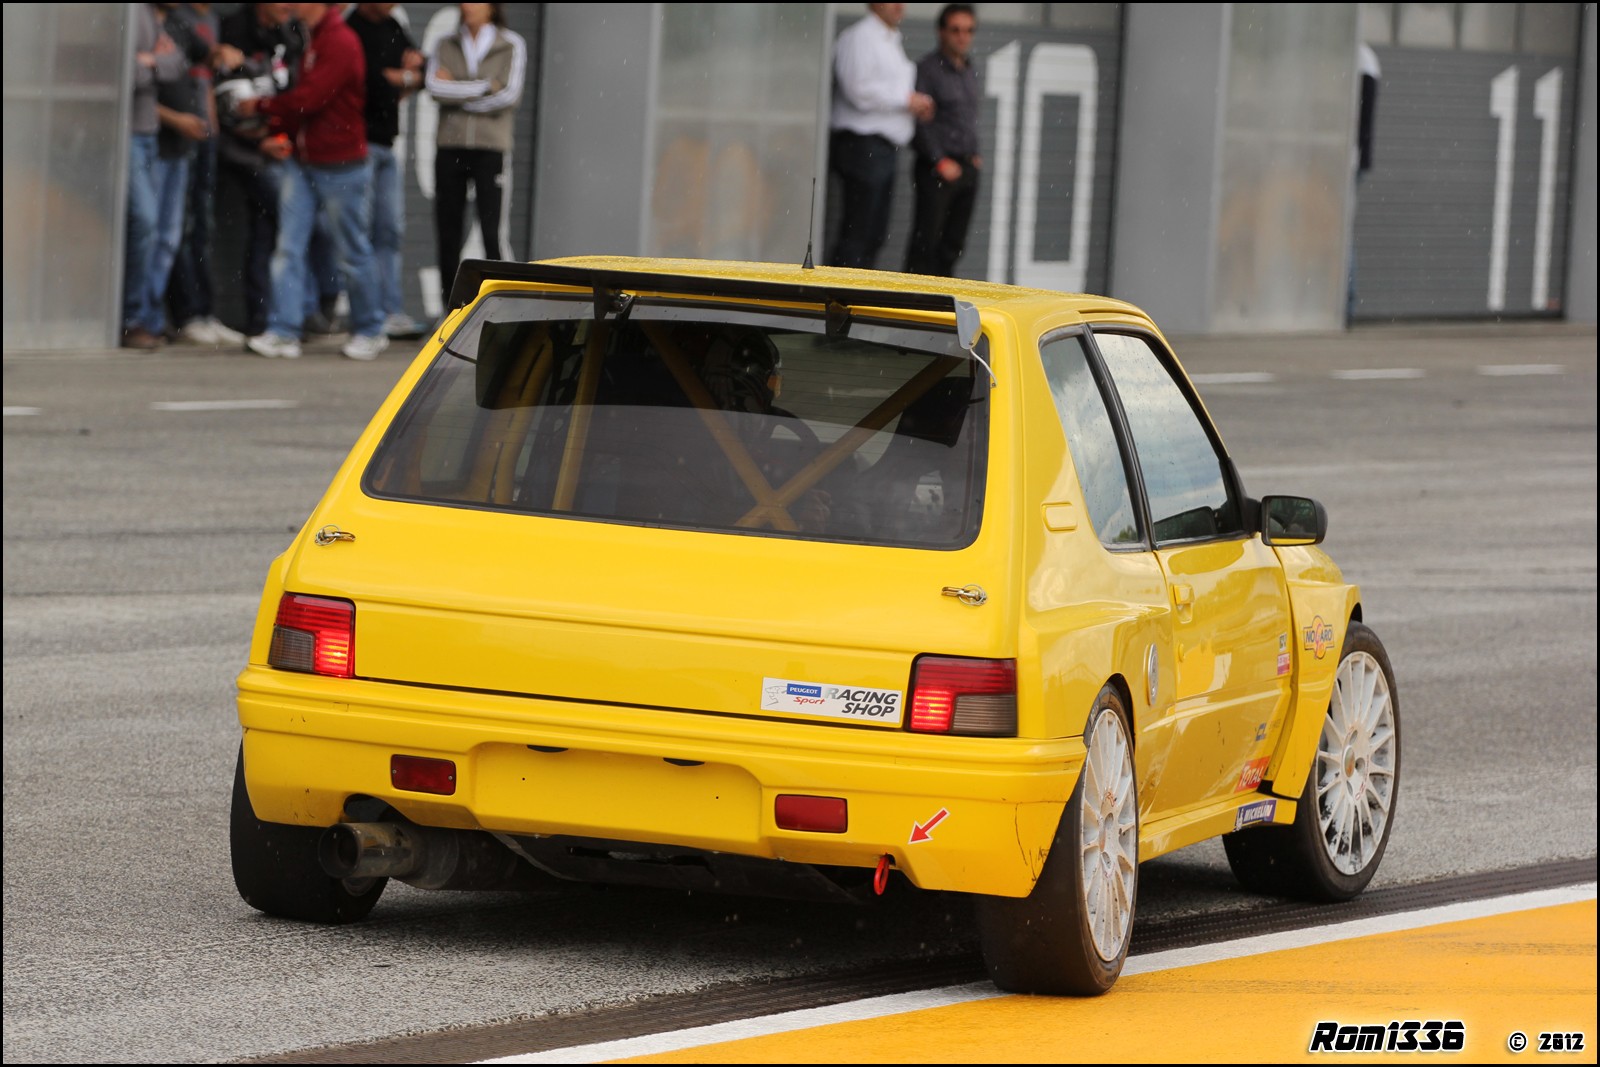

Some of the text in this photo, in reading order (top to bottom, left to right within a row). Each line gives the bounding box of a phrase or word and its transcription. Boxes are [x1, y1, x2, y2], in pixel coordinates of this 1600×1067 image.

[985, 39, 1098, 294] 10
[1487, 65, 1563, 311] 11
[789, 686, 818, 694] PEUGEOT
[826, 688, 898, 705] RACING
[793, 696, 825, 705] Sport
[841, 702, 895, 717] SHOP
[1239, 765, 1264, 787] TOTAL
[1243, 804, 1273, 822] MICHELIN
